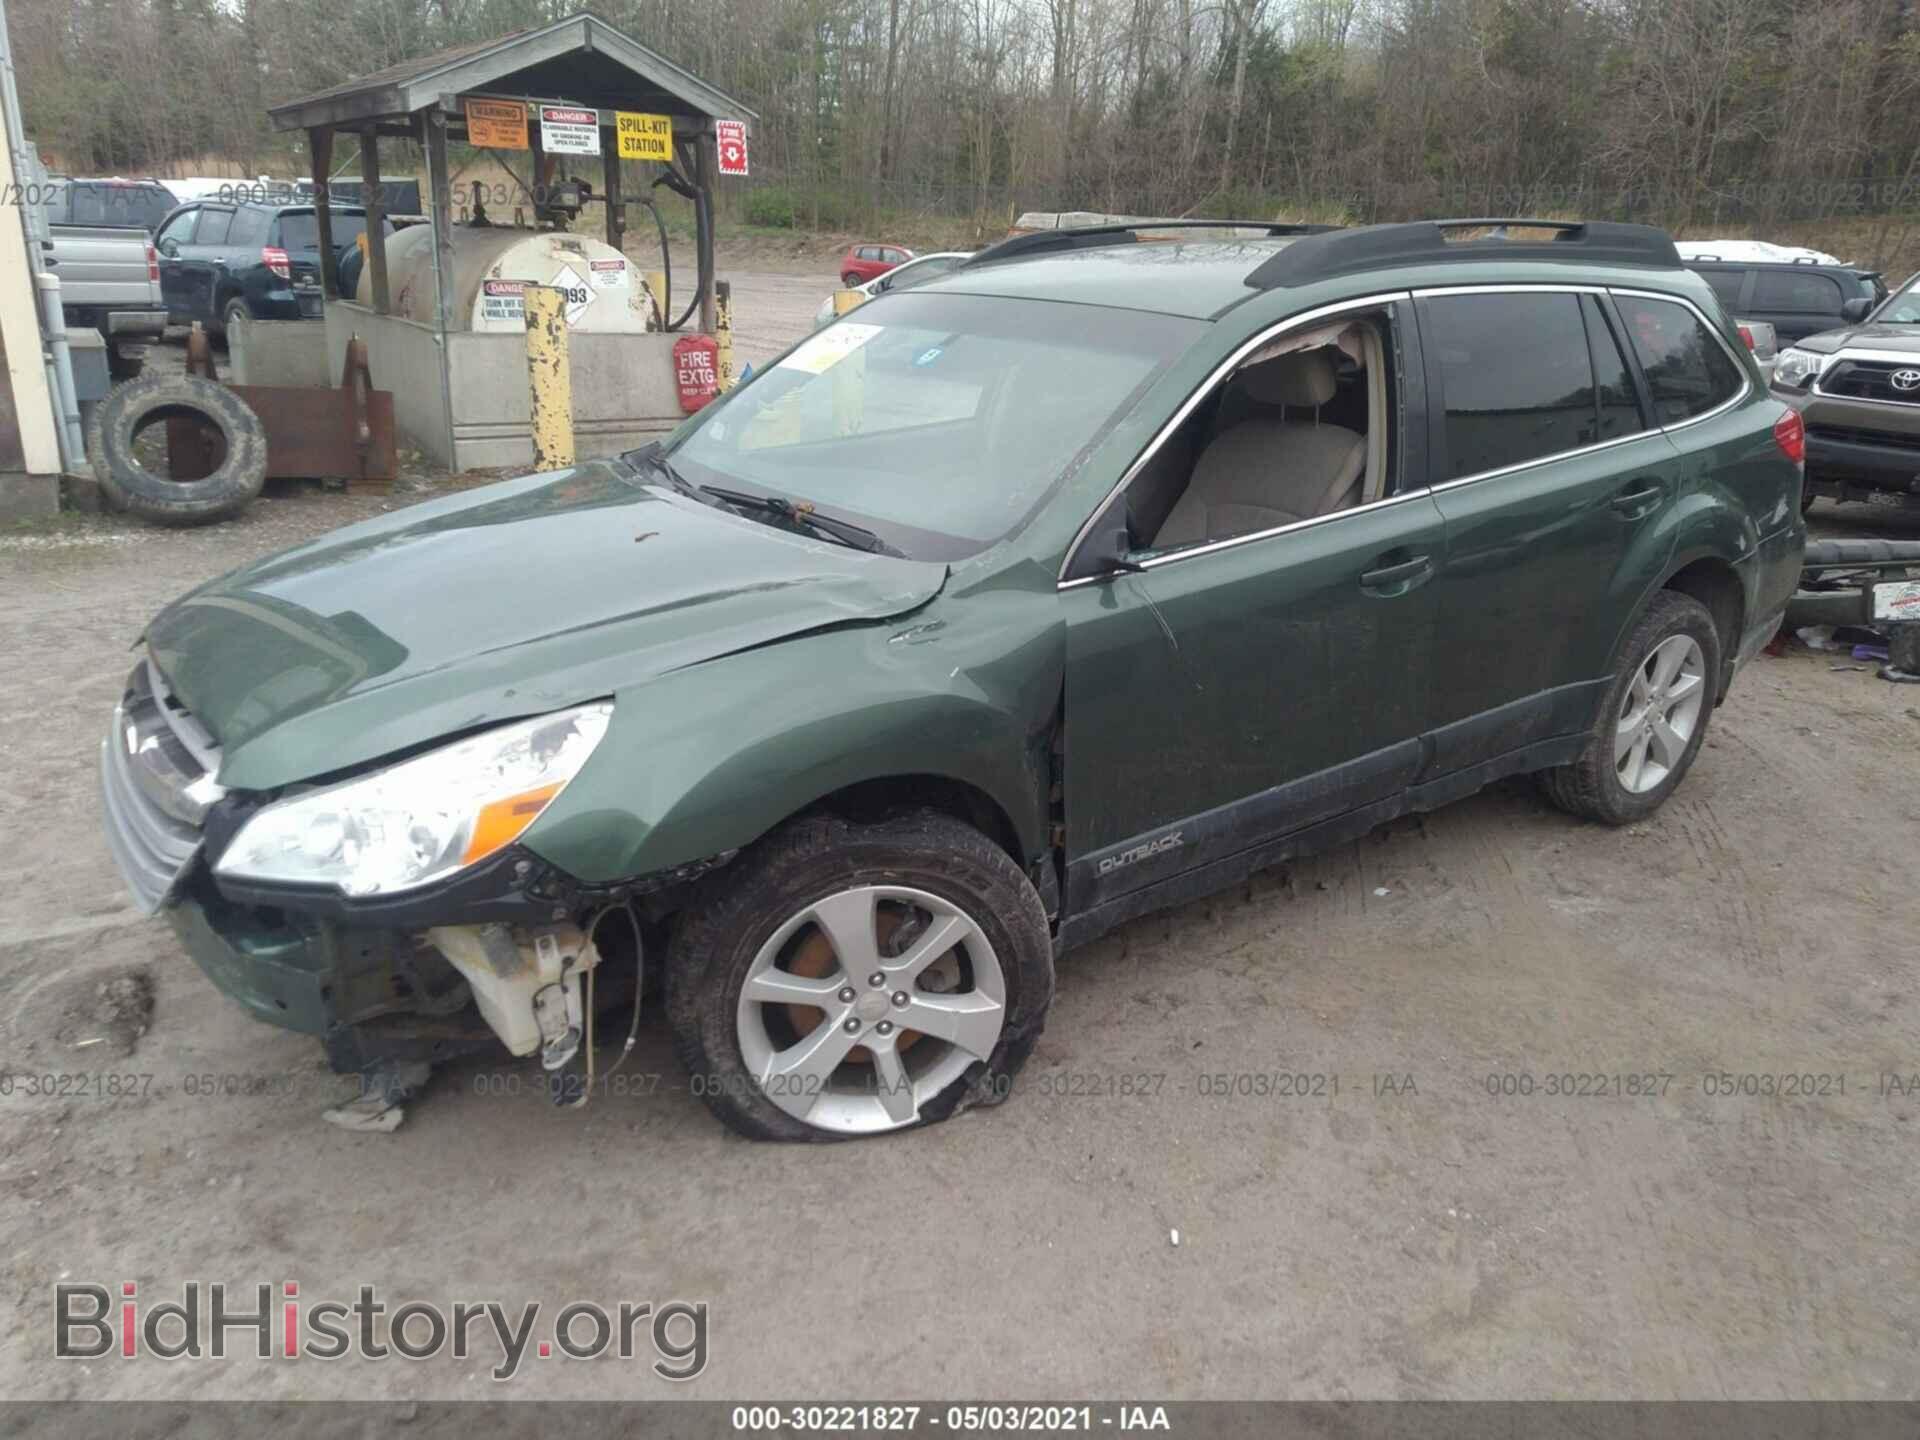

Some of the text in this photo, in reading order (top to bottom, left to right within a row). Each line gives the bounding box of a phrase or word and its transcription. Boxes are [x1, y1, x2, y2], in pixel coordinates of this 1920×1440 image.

[551, 110, 588, 122] DANGER
[619, 118, 668, 135] SPILL-KIT
[624, 137, 665, 153] STATION
[491, 283, 524, 295] DANGE
[680, 351, 711, 368] FIRE
[1099, 831, 1184, 874] OUTBACK
